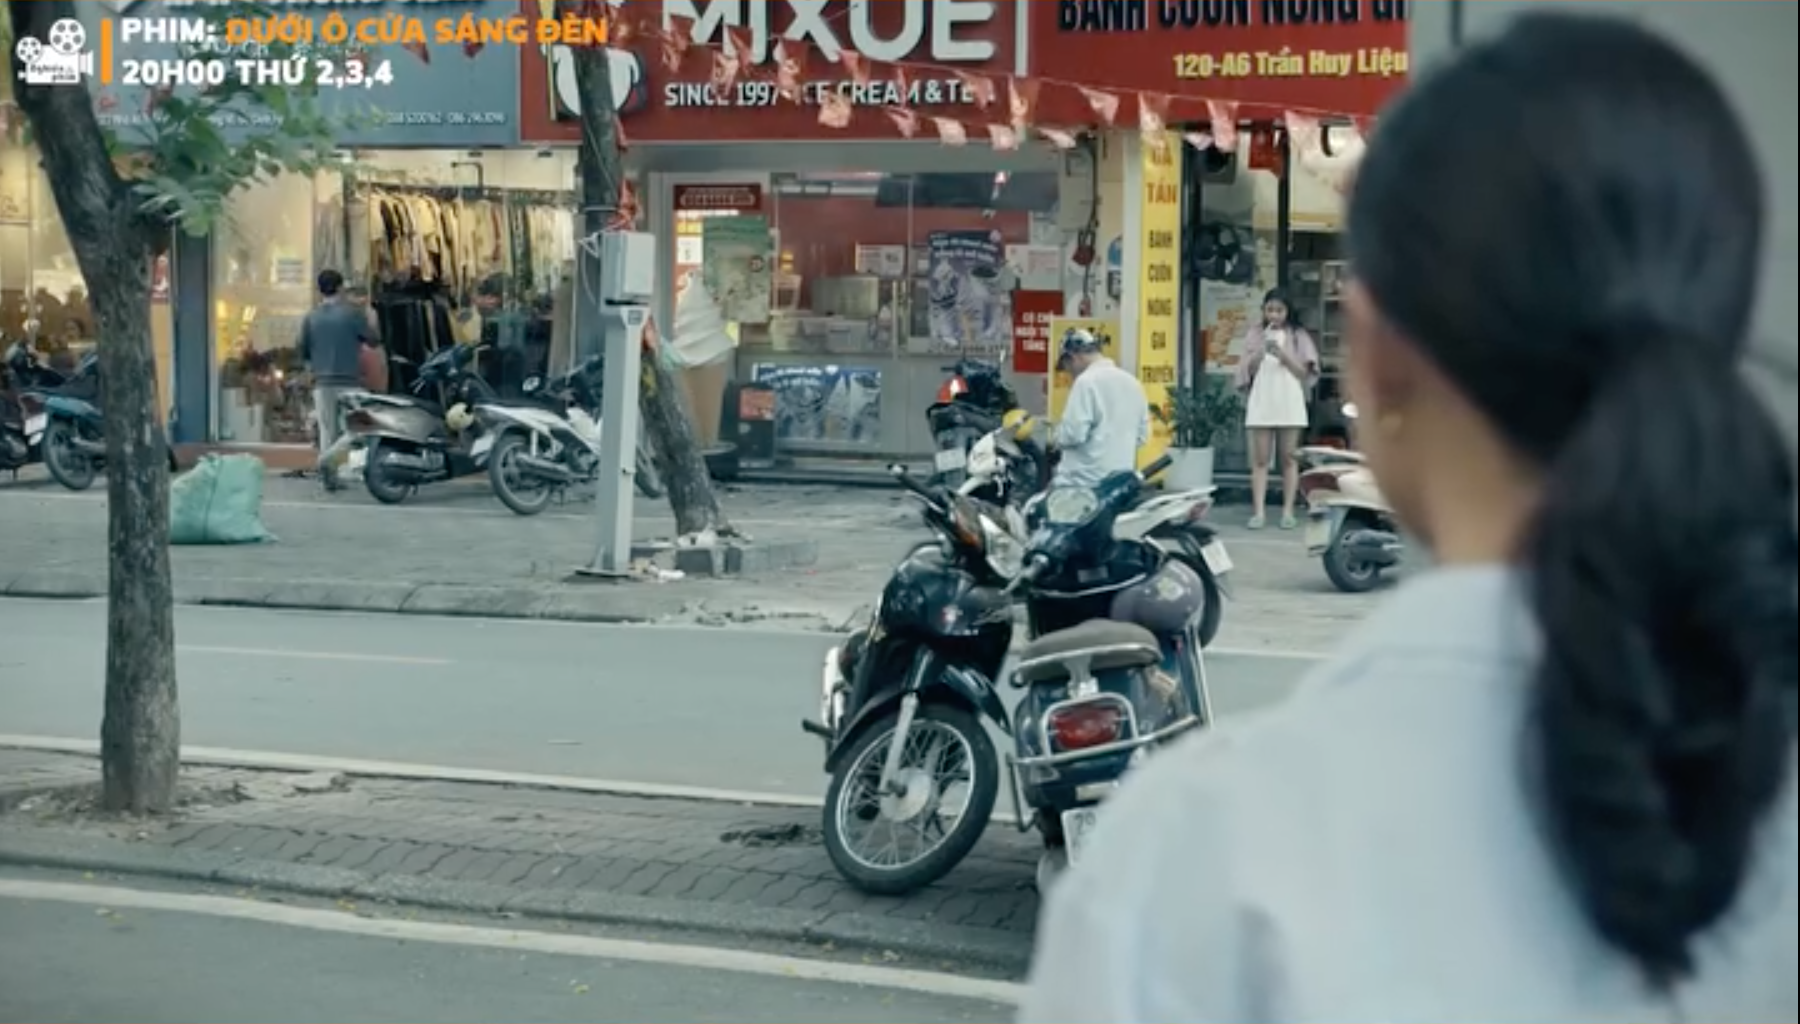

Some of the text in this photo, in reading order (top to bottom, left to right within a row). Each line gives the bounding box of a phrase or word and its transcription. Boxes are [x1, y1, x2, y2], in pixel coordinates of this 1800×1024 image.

[663, 0, 996, 63] MIXUE
[1172, 51, 1251, 78] 120-A6
[1309, 49, 1352, 77] Huy
[1357, 46, 1409, 77] Liệu
[924, 79, 942, 103] &
